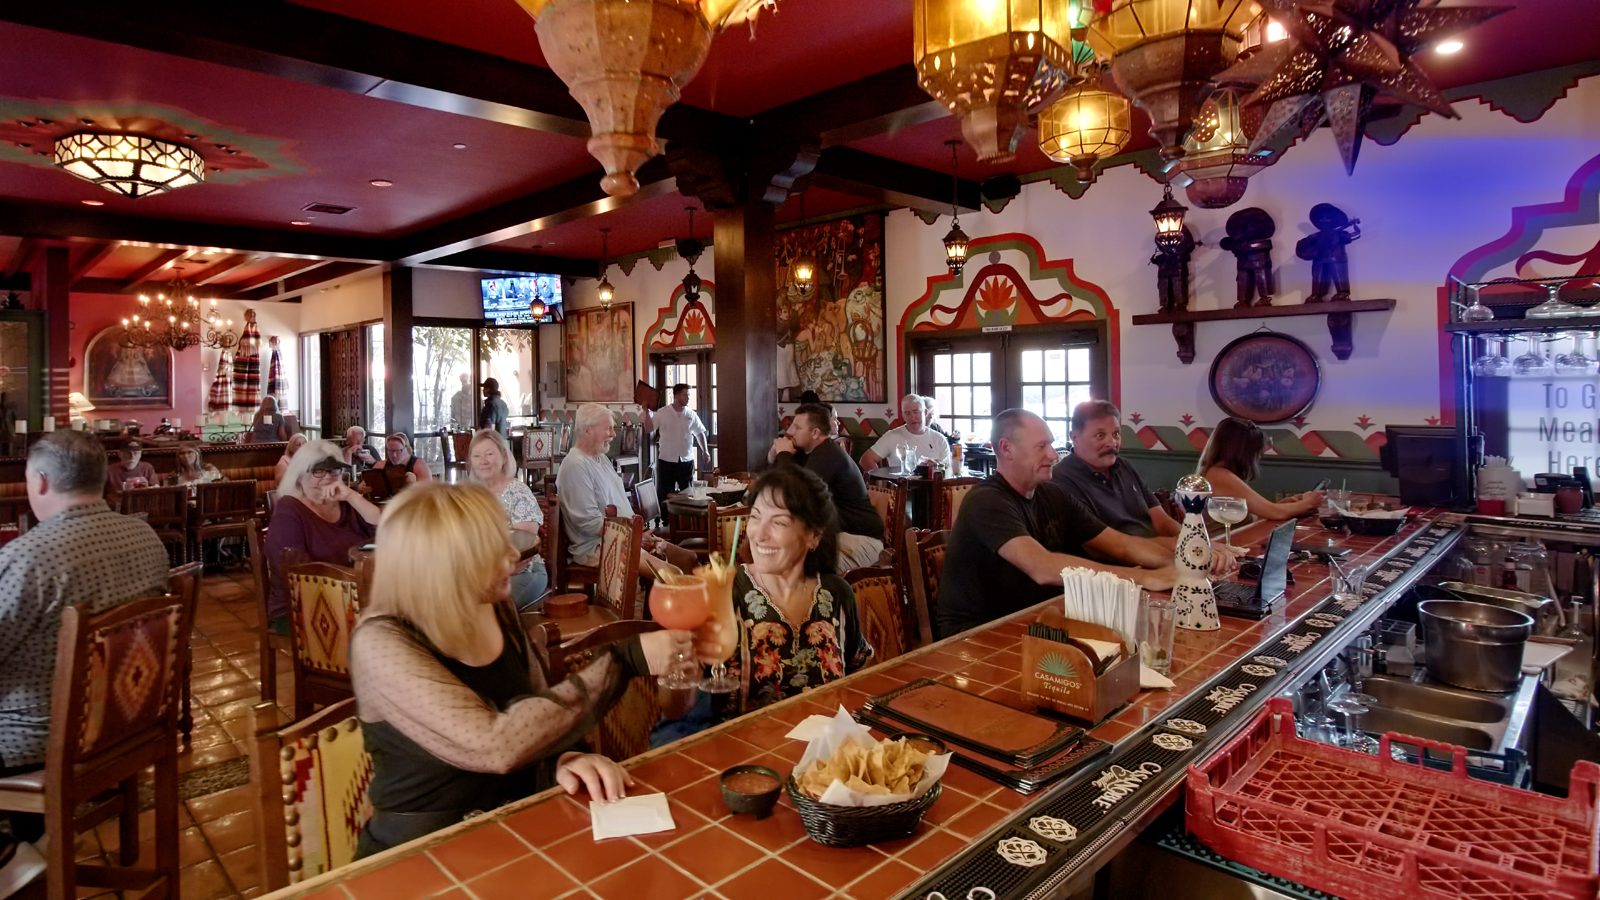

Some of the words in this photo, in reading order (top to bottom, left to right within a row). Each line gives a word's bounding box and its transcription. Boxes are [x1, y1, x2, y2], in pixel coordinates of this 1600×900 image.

[1542, 383, 1568, 409] To
[1581, 383, 1597, 409] G
[1539, 416, 1600, 443] Meal
[1034, 671, 1081, 690] CASAMIGOS
